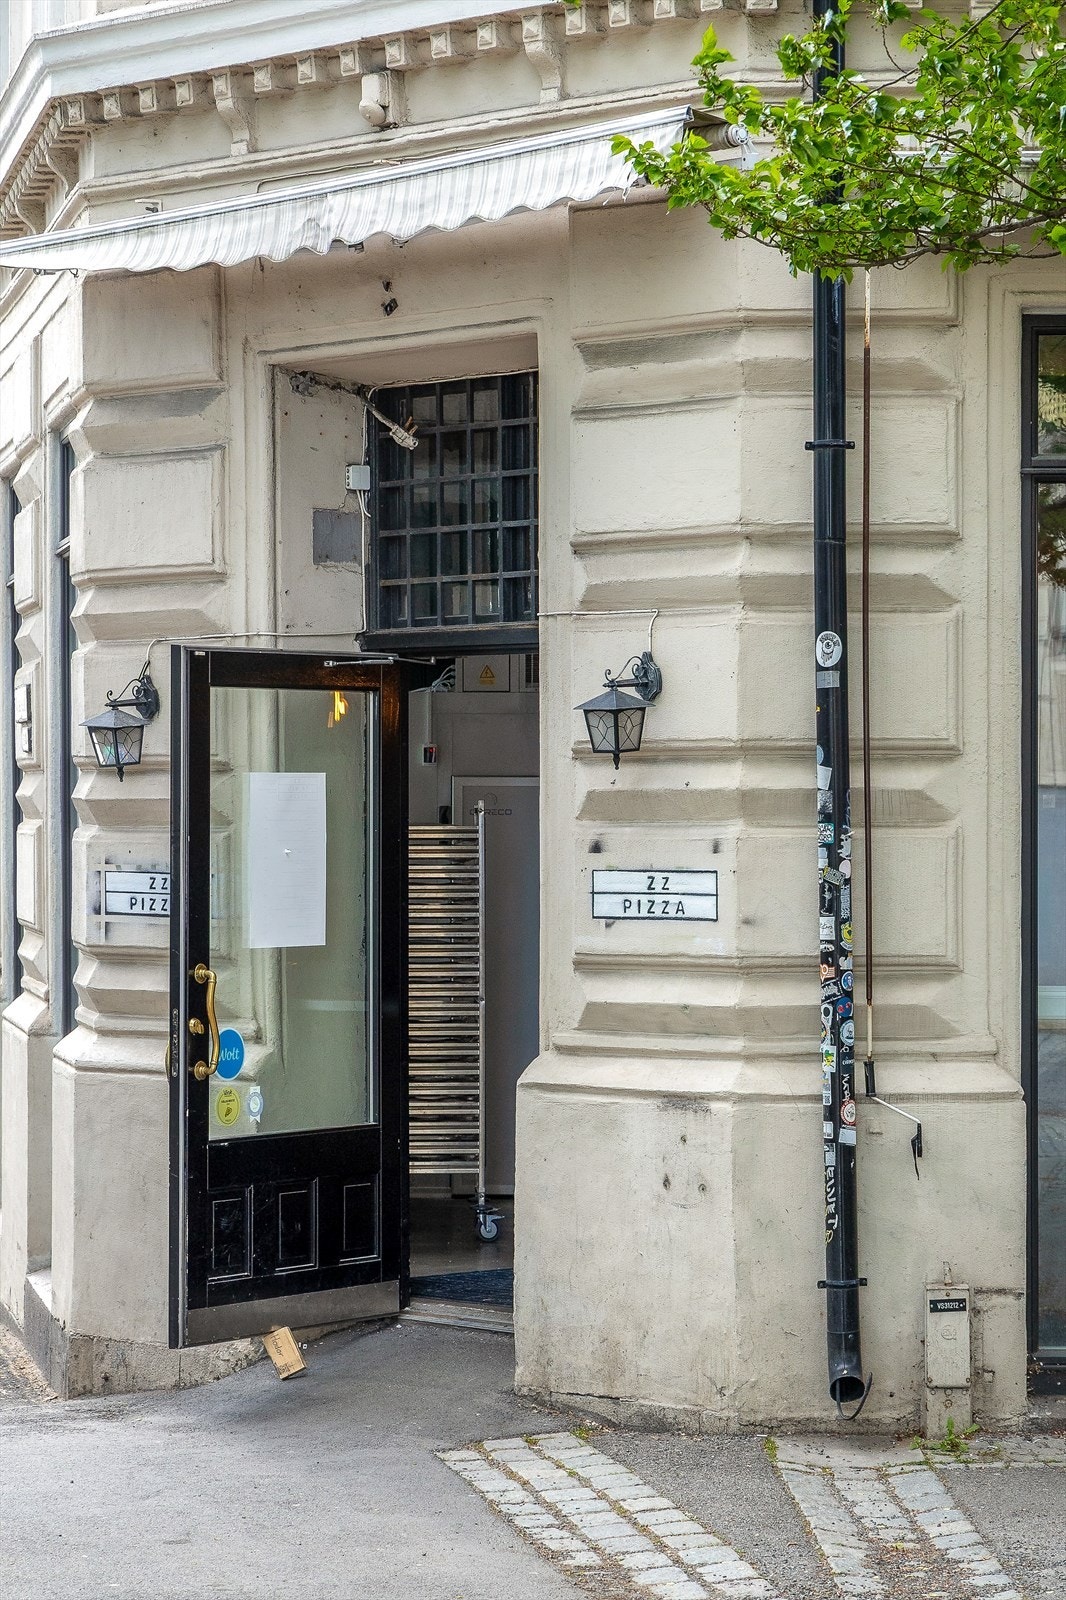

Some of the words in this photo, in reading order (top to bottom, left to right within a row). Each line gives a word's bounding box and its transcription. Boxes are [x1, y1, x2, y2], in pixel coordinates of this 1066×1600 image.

[469, 808, 513, 816] CRECO
[148, 876, 169, 891] ZZ
[646, 875, 671, 892] ZZ
[129, 897, 169, 912] PIZZ
[623, 898, 686, 915] PIZZA
[218, 1046, 240, 1061] Wolt
